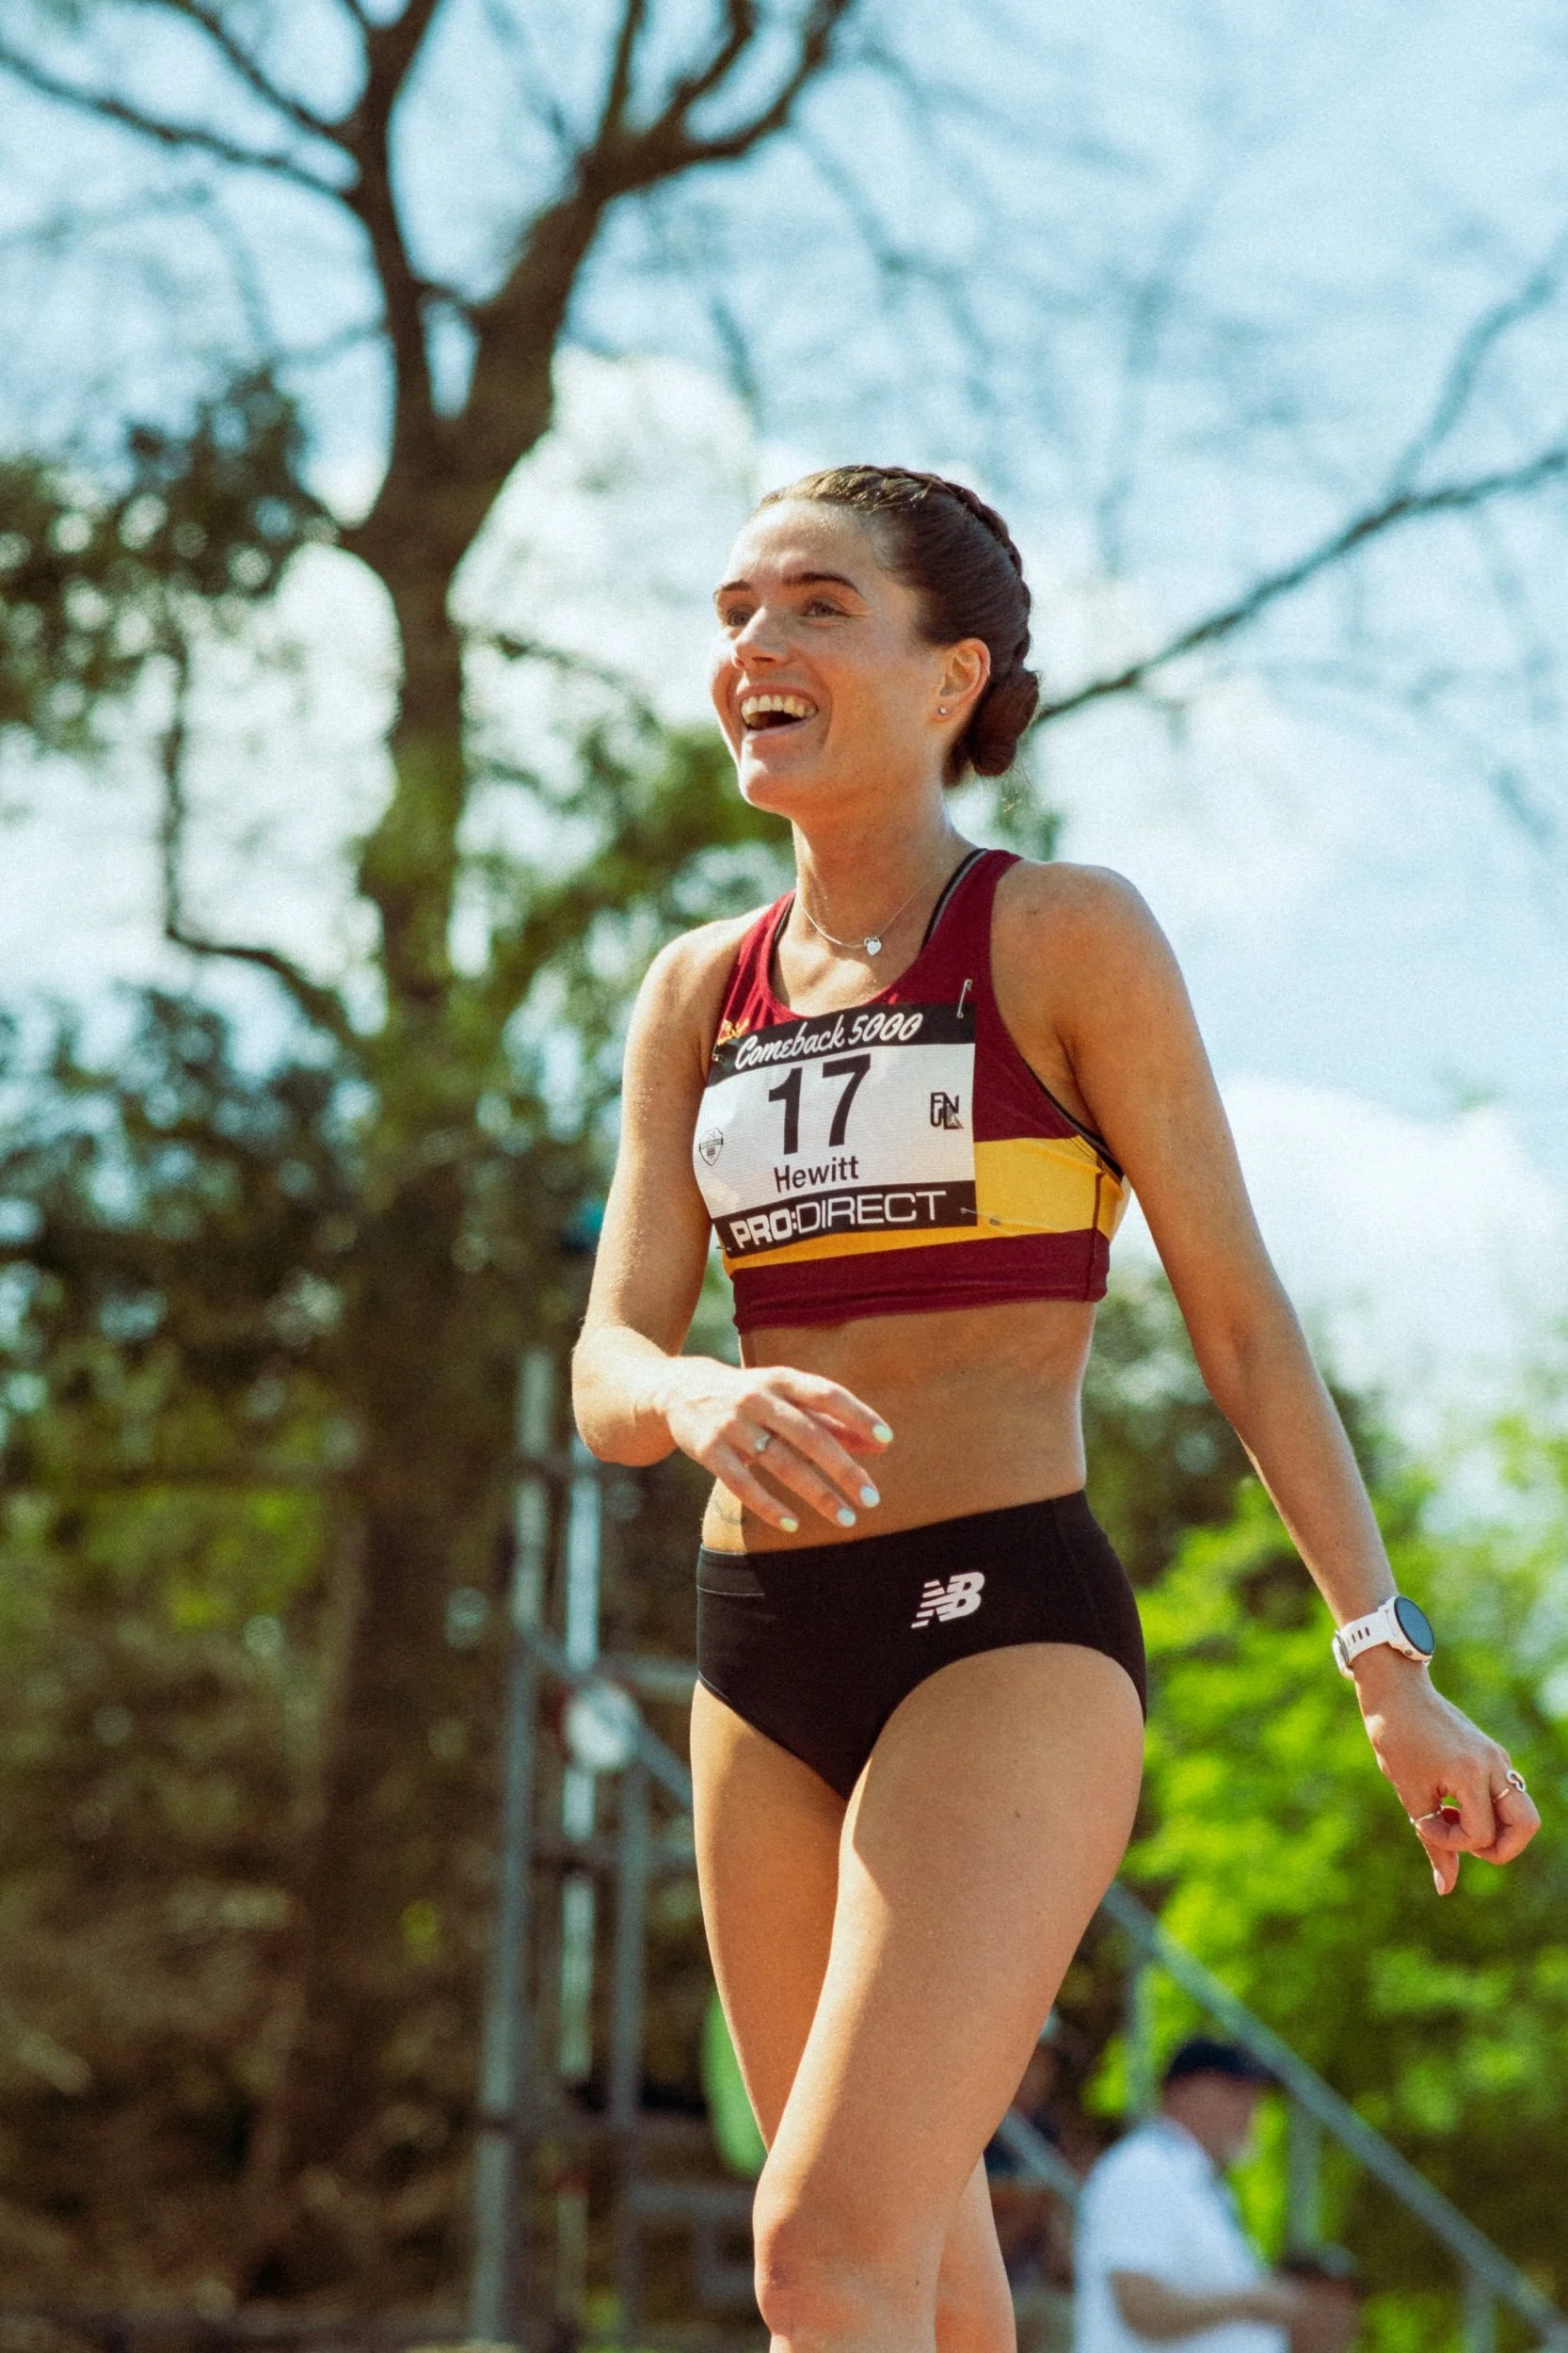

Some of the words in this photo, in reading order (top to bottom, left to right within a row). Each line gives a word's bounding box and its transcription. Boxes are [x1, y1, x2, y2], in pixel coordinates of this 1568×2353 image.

[735, 1014, 845, 1070] Comeback
[848, 1012, 923, 1045] 5000
[768, 1053, 871, 1155] 17
[774, 1155, 859, 1193] Hewitt
